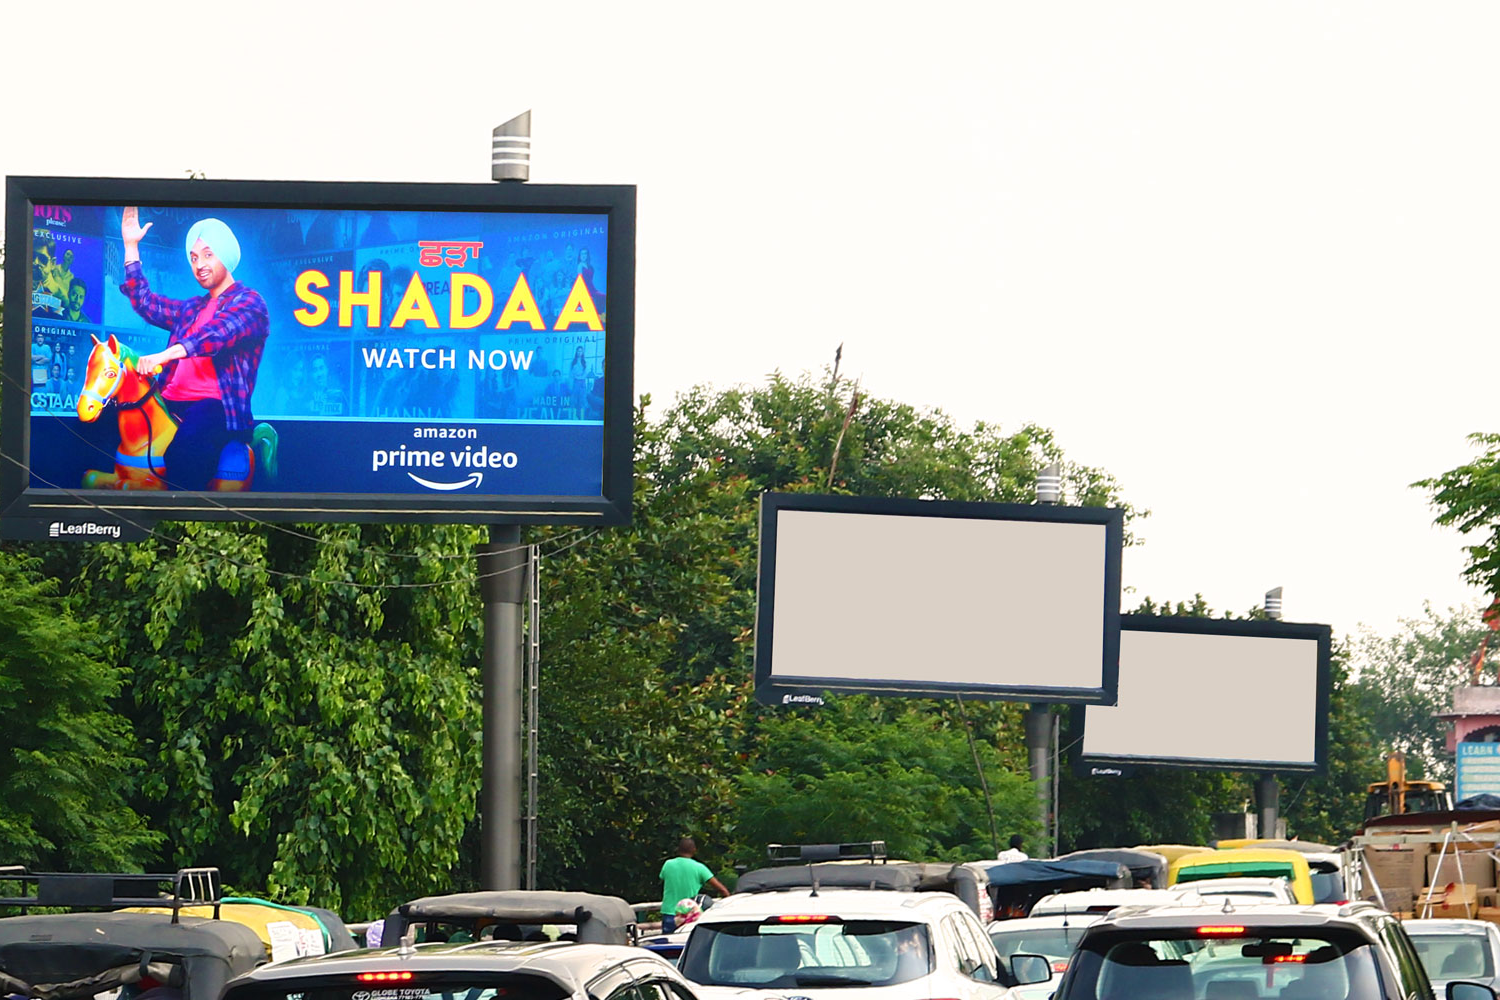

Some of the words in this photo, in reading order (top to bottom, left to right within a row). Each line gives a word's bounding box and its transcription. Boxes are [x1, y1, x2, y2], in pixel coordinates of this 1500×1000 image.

[34, 231, 83, 244] EXCLUSIVE
[293, 269, 605, 331] SHADAA
[34, 326, 77, 337] ORIGINAL
[361, 347, 456, 370] WATCH
[468, 349, 534, 371] NOW
[413, 427, 477, 439] amazon
[372, 444, 445, 472] prime
[449, 445, 518, 469] video
[60, 522, 121, 538] LeafBerry
